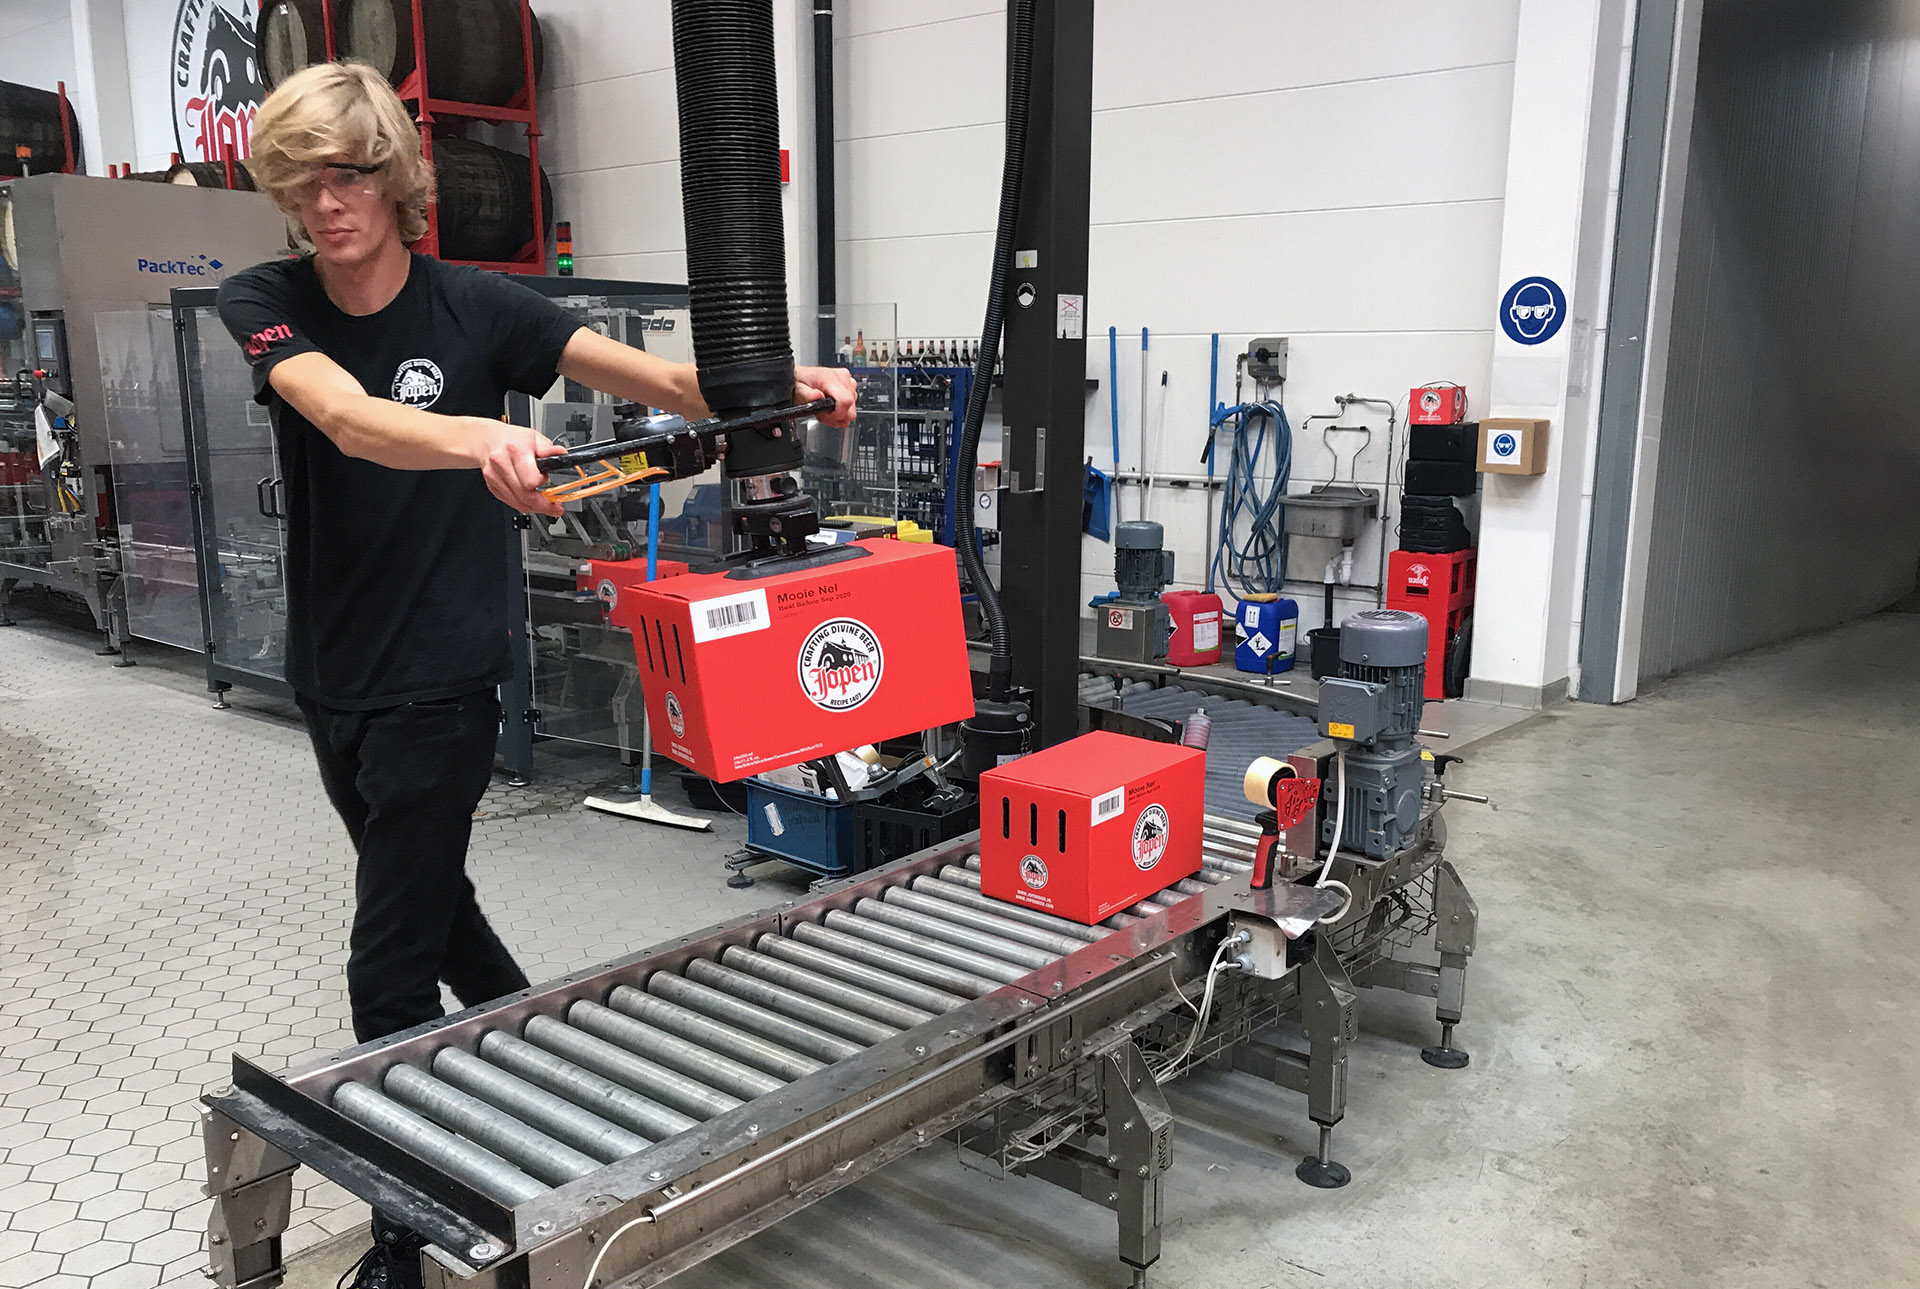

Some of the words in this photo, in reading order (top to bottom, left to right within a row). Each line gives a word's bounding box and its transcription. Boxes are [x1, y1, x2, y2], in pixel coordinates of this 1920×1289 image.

[137, 258, 205, 276] PackTec
[777, 589, 815, 603] Mooie
[818, 583, 838, 595] Nel
[796, 599, 819, 608] Before
[820, 596, 834, 604] Sep
[835, 591, 852, 600] 2020
[804, 629, 830, 667] CRAFTING
[831, 624, 860, 637] DIVINE
[859, 633, 875, 654] BEER
[808, 661, 876, 702] Jopen
[830, 698, 849, 707] RECIPE
[1136, 833, 1164, 863] Jopen
